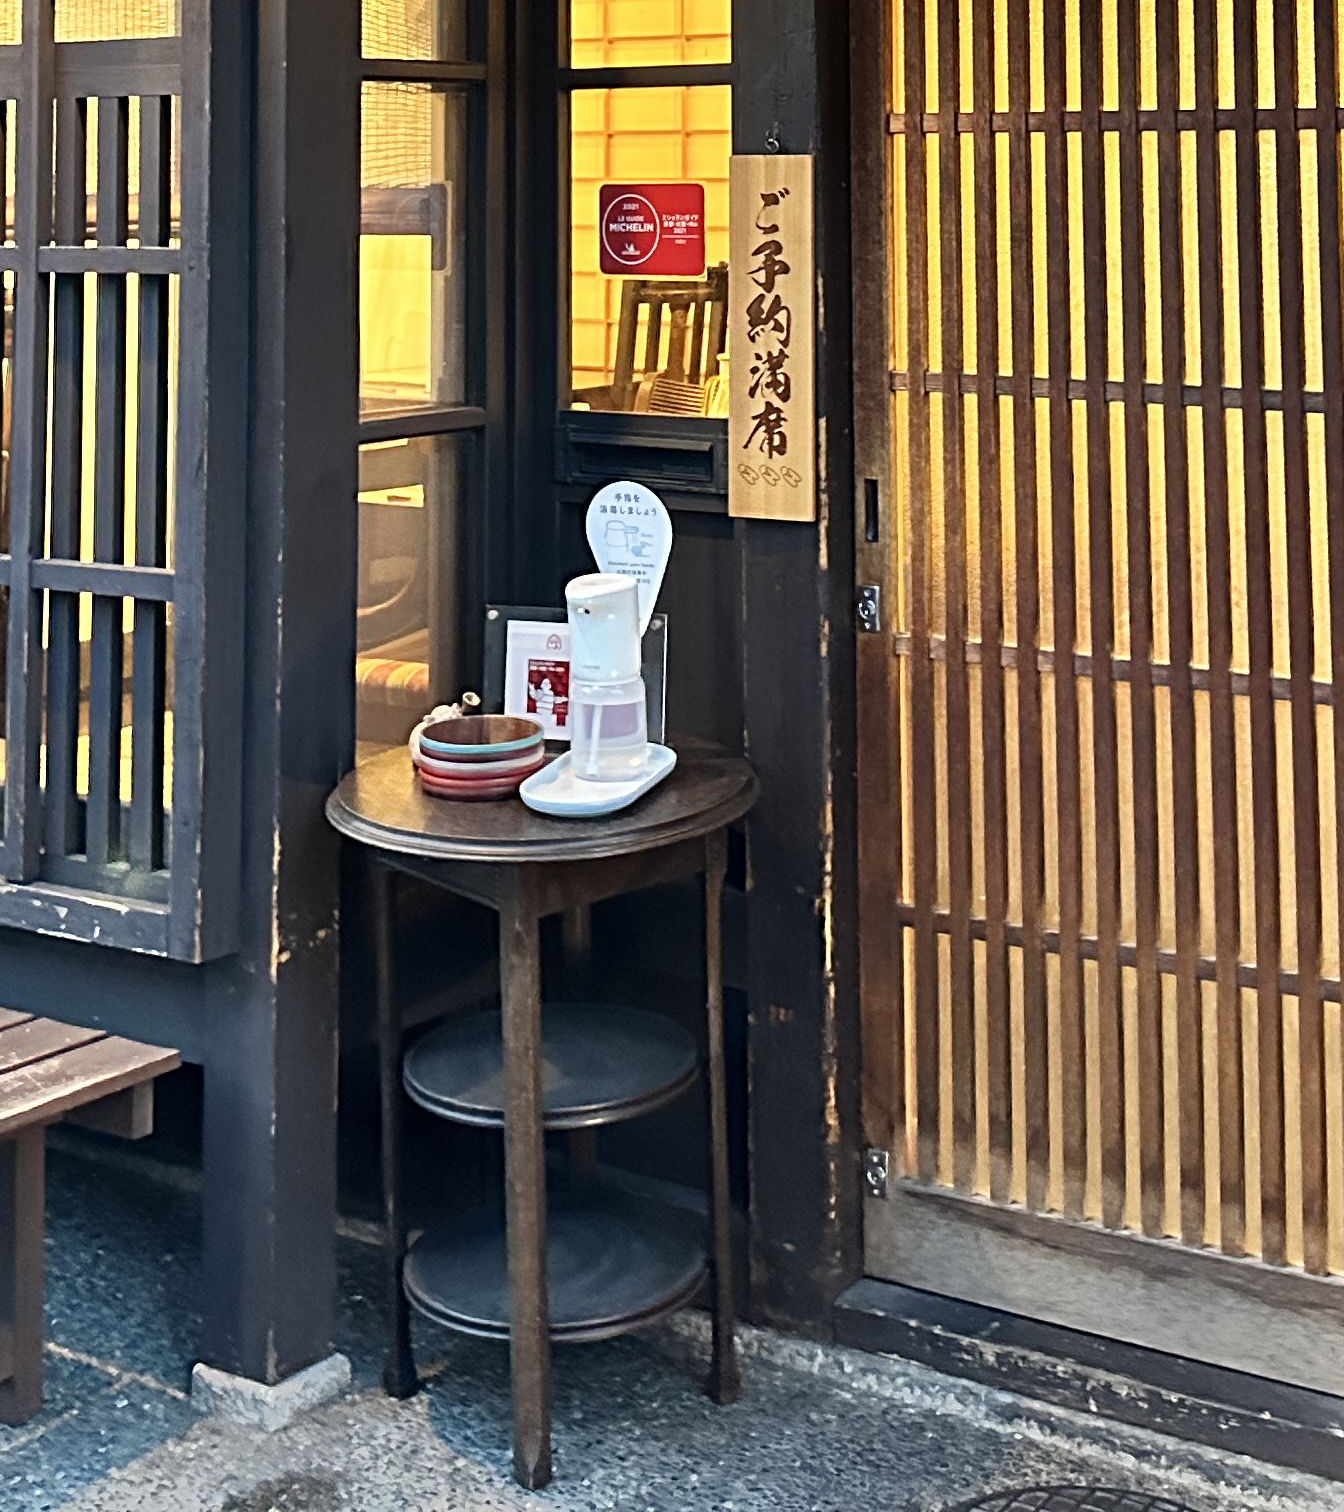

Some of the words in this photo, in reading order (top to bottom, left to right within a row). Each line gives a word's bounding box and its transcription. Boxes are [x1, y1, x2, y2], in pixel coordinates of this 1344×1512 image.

[609, 222, 654, 232] MICHELIN
[742, 187, 792, 459] ご予約満席
